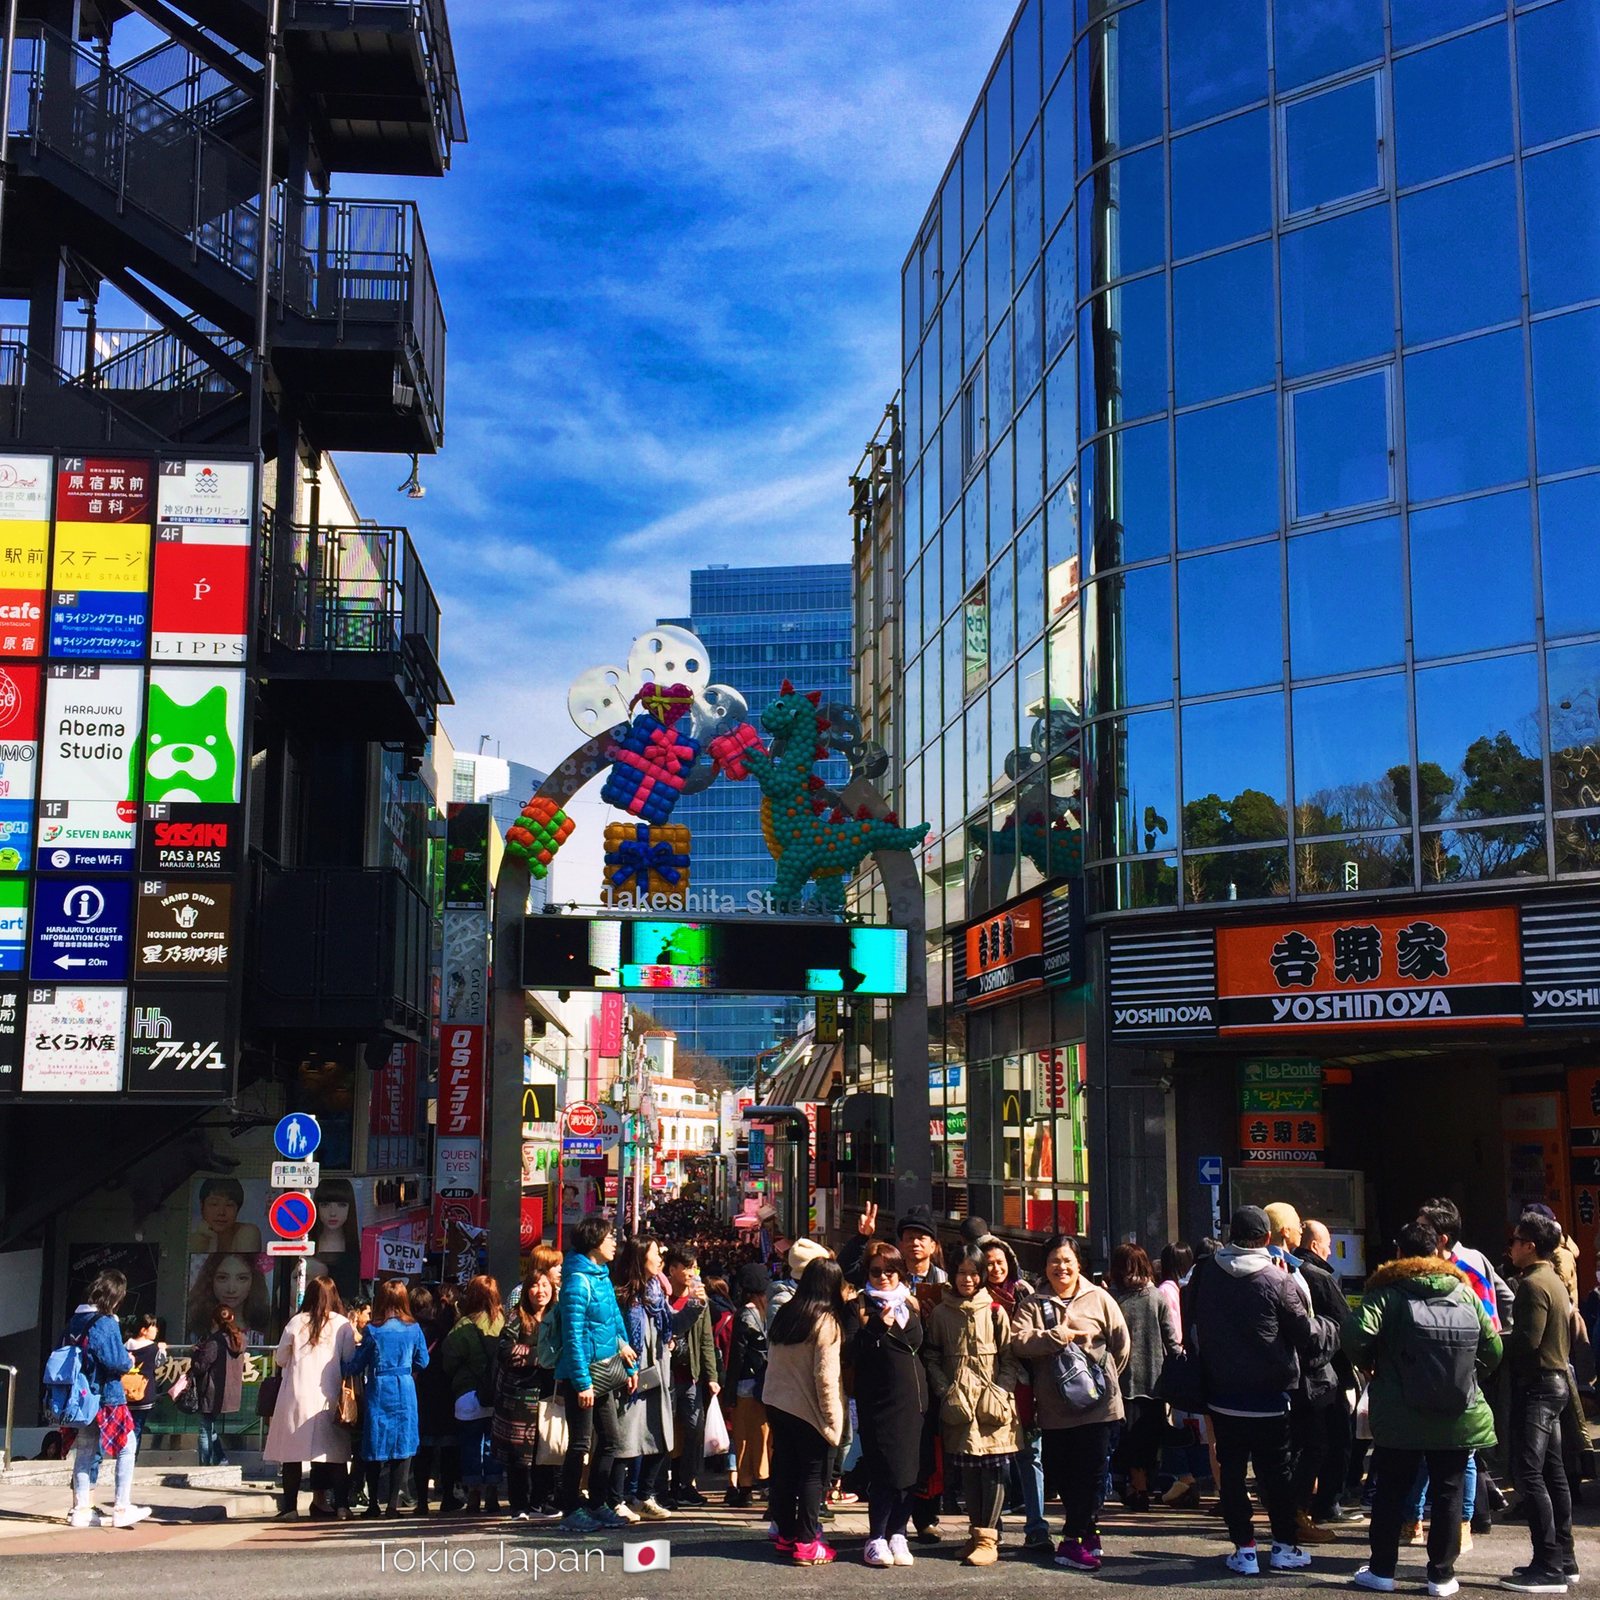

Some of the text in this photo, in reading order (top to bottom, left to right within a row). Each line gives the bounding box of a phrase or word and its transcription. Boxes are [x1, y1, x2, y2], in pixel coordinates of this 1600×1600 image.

[64, 458, 81, 471] 7F
[165, 461, 182, 474] 7F
[68, 475, 144, 491] 原宿駅前
[88, 499, 124, 514] 歯科
[161, 527, 179, 541] 4F
[5, 548, 44, 564] 駅前
[60, 550, 142, 567] ステージ
[58, 594, 75, 604] 5F
[0, 602, 40, 619] cafe
[3, 636, 35, 651] 原宿
[155, 641, 245, 654] LIPPS
[54, 666, 95, 677] 1F 2F
[64, 704, 123, 715] HARAJUKU
[59, 719, 125, 737] Abema
[60, 742, 123, 760] Studio
[46, 803, 62, 816] 1F
[148, 804, 166, 819] 1F
[66, 829, 132, 840] SEVEN BANK
[154, 822, 228, 848] SASAKI
[75, 854, 122, 864] Free Wi-Fi
[160, 850, 184, 861] PAS
[197, 851, 221, 862] PAS
[144, 880, 161, 894] BF
[161, 892, 216, 907] HAND DRIP
[600, 884, 833, 916] Takeshita Street
[94, 934, 123, 942] CENTER
[147, 931, 225, 939] HOSHINO COFFEE
[979, 915, 1015, 969] 吉野家
[88, 958, 108, 966] 20m
[142, 944, 229, 966] 星乃珈琲
[1269, 920, 1449, 989] 吉野家
[979, 965, 1015, 993] YOSHINOYA
[33, 989, 51, 1002] BF
[1271, 990, 1452, 1022] YOSHINOYA
[1114, 1005, 1213, 1026] YOSHINOYA
[606, 999, 618, 1050] DAISO
[35, 1033, 116, 1051] さくら水産
[148, 1041, 227, 1070] アッシュ
[571, 1114, 595, 1126] 消火栓
[1249, 1120, 1318, 1144] 吉野家
[441, 1150, 477, 1160] QUEEN
[1249, 1149, 1318, 1161] YOSHINOYA
[446, 1162, 470, 1172] EYES
[304, 1176, 313, 1185] 18
[384, 1243, 420, 1259] OPEN
